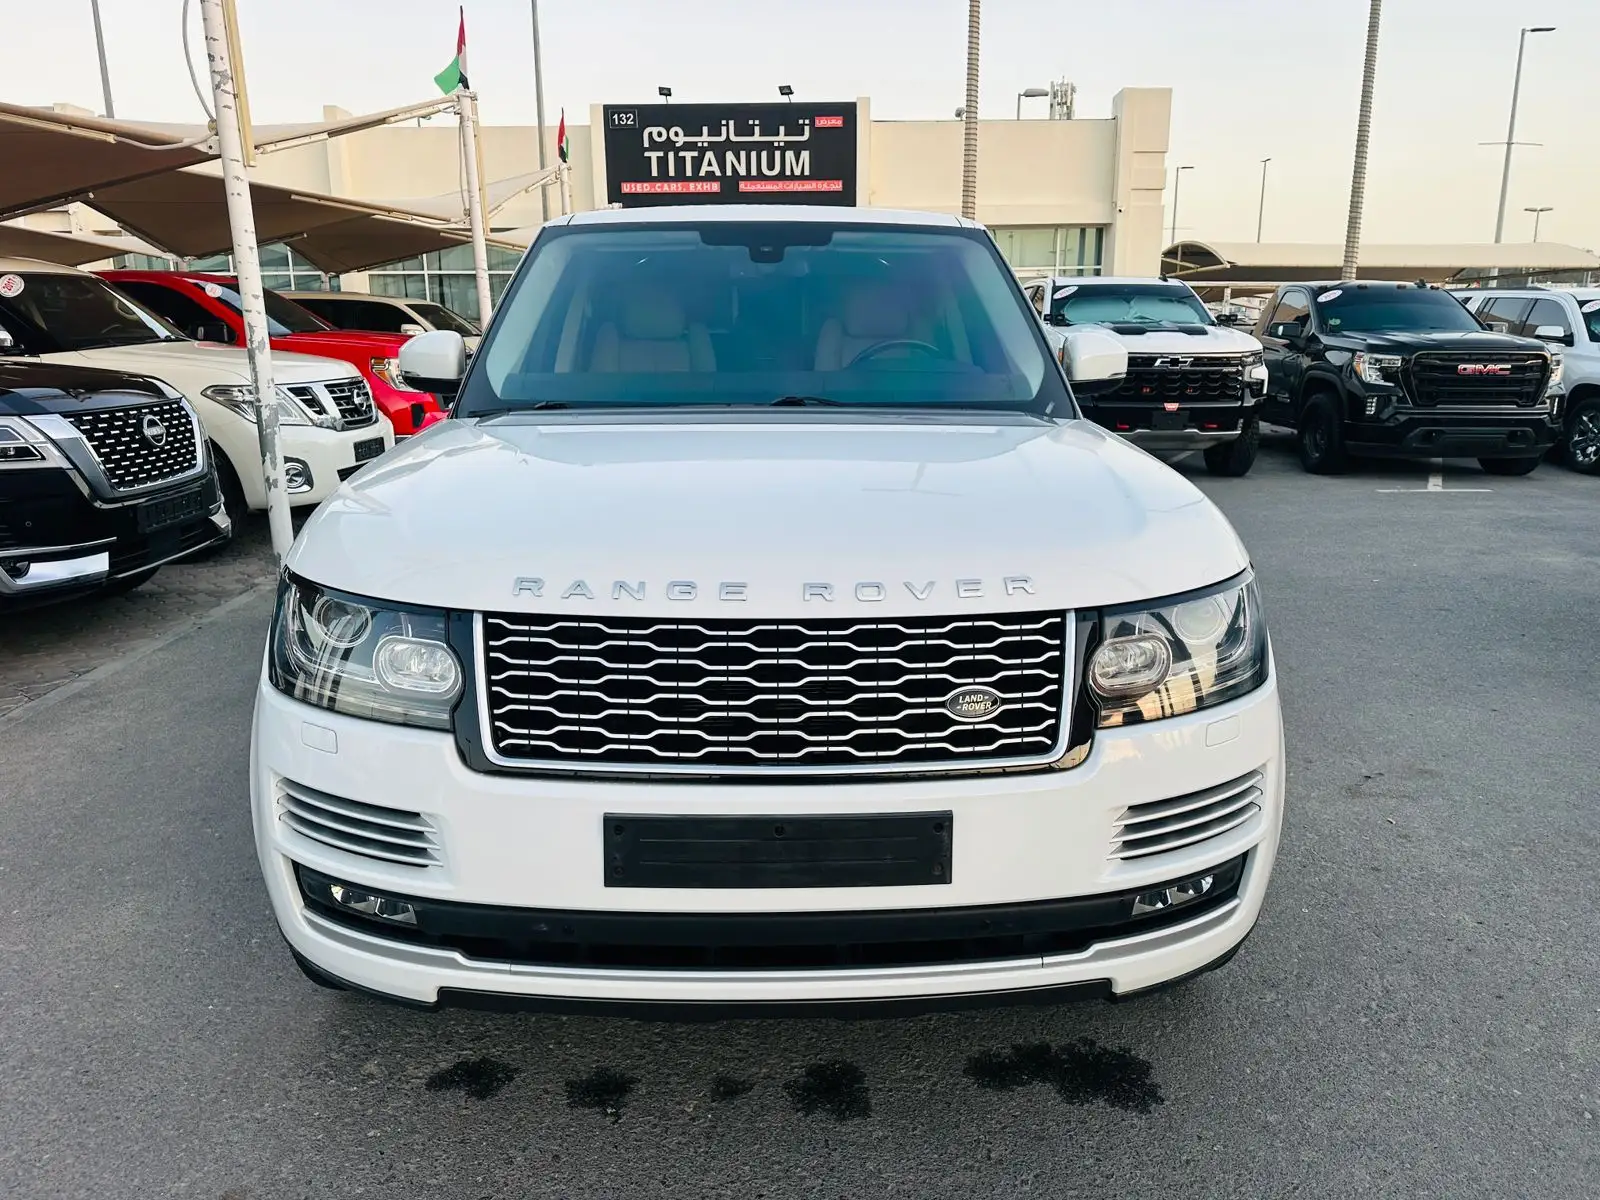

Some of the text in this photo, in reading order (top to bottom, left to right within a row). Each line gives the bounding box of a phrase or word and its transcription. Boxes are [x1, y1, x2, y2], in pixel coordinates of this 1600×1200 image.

[612, 113, 634, 125] 132
[816, 118, 842, 127] معرض
[643, 119, 810, 147] تيتانيوم
[644, 150, 810, 176] TITANIUM
[1457, 364, 1512, 375] GMC
[511, 575, 1036, 603] RANGE ROVER
